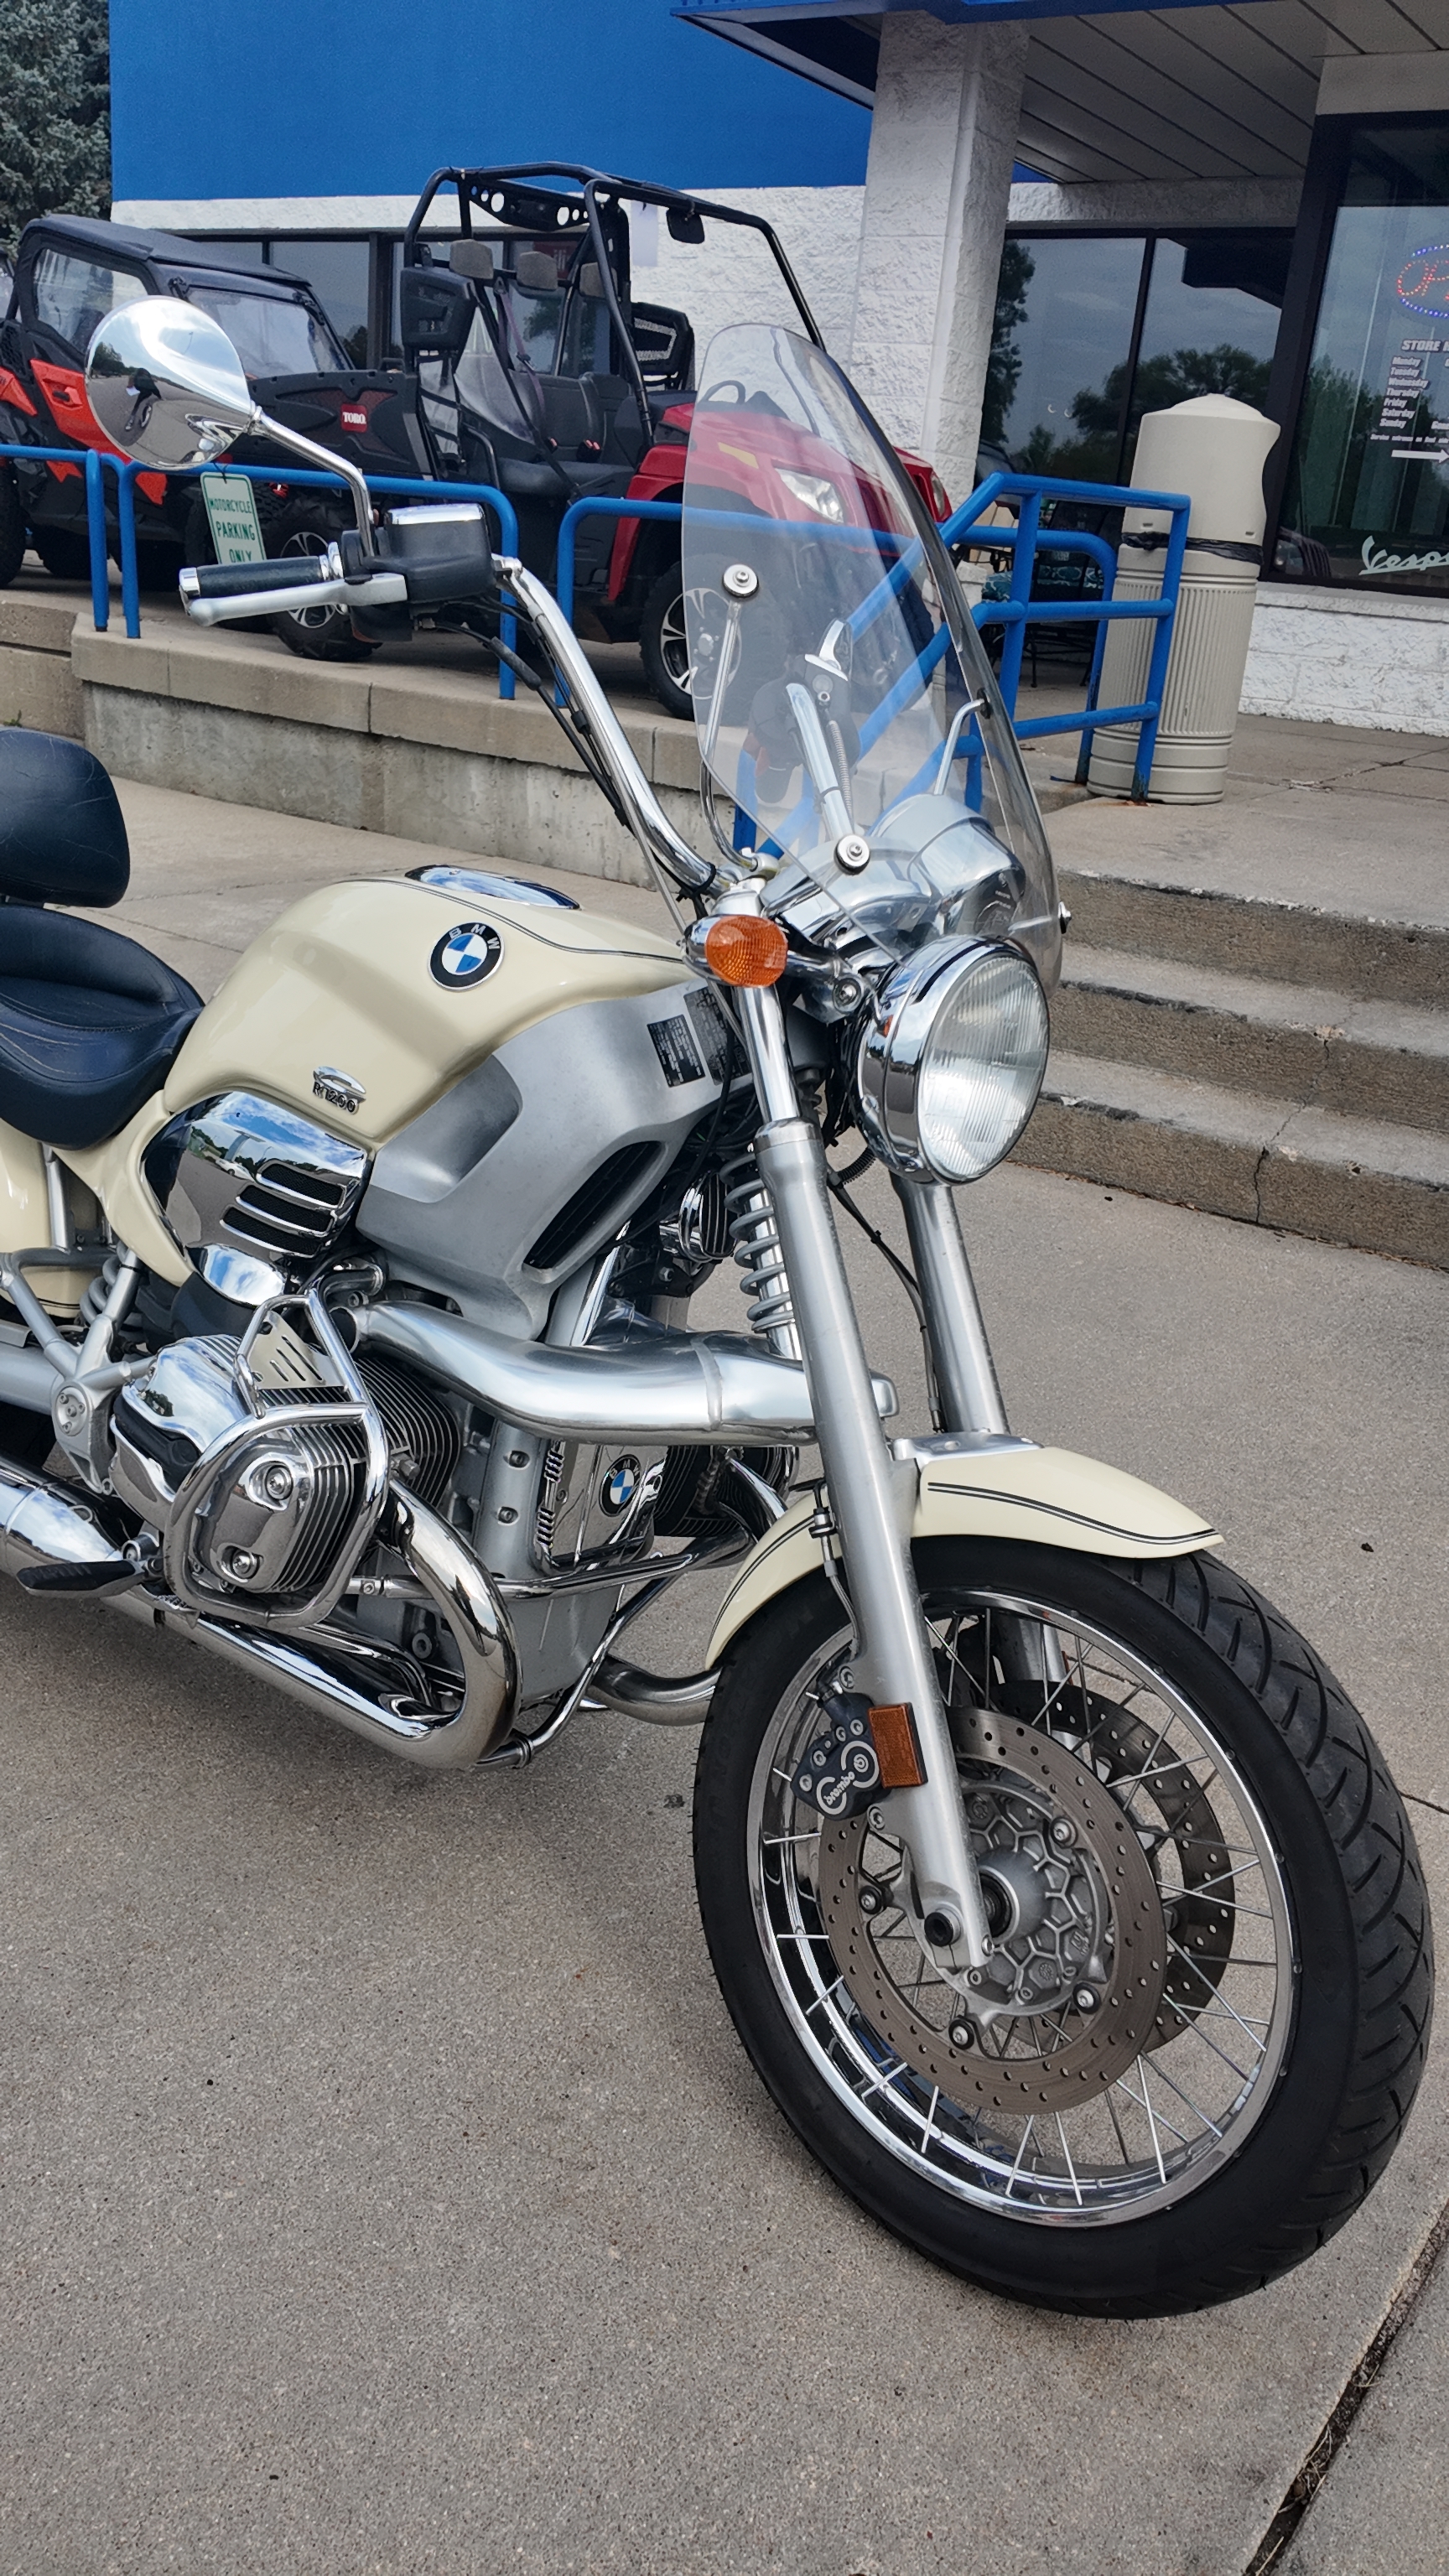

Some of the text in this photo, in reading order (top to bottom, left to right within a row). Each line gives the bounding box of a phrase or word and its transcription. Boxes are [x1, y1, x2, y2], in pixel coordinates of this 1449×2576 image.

[1401, 340, 1441, 351] STORE
[1383, 397, 1408, 408] Friday
[342, 411, 367, 424] TORO
[1381, 408, 1415, 419] Saturday
[1379, 418, 1407, 428] Sunday
[208, 497, 252, 513] MOTORCYCLE
[216, 521, 256, 541] PARKING
[449, 923, 501, 950] BMW
[609, 1459, 641, 1480] BMW
[823, 1771, 855, 1806] brembo
